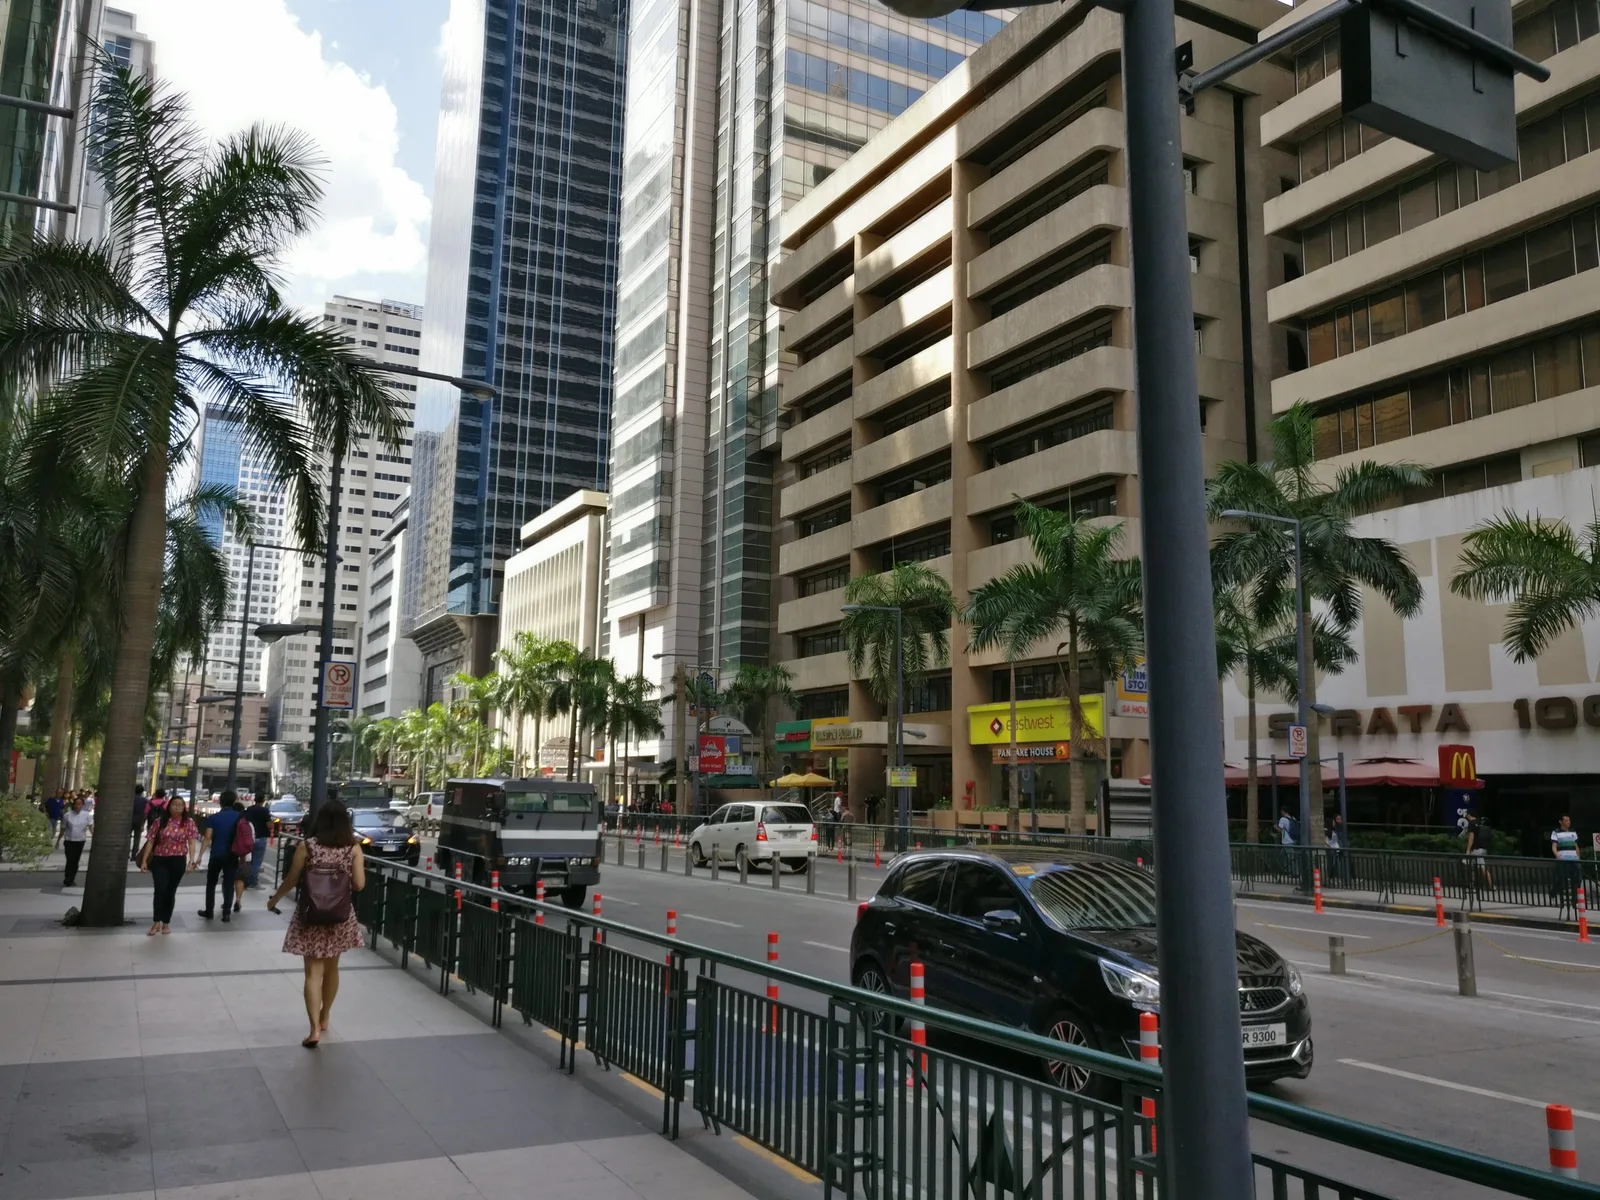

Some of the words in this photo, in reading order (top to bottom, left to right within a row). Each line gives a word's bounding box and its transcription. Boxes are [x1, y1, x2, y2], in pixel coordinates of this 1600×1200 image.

[1128, 681, 1147, 689] STO
[1268, 703, 1470, 738] SRATA
[998, 748, 1028, 758] PANAKE
[1031, 747, 1054, 757] HOUSE
[1242, 1033, 1250, 1043] R
[1252, 1031, 1276, 1043] 9300
